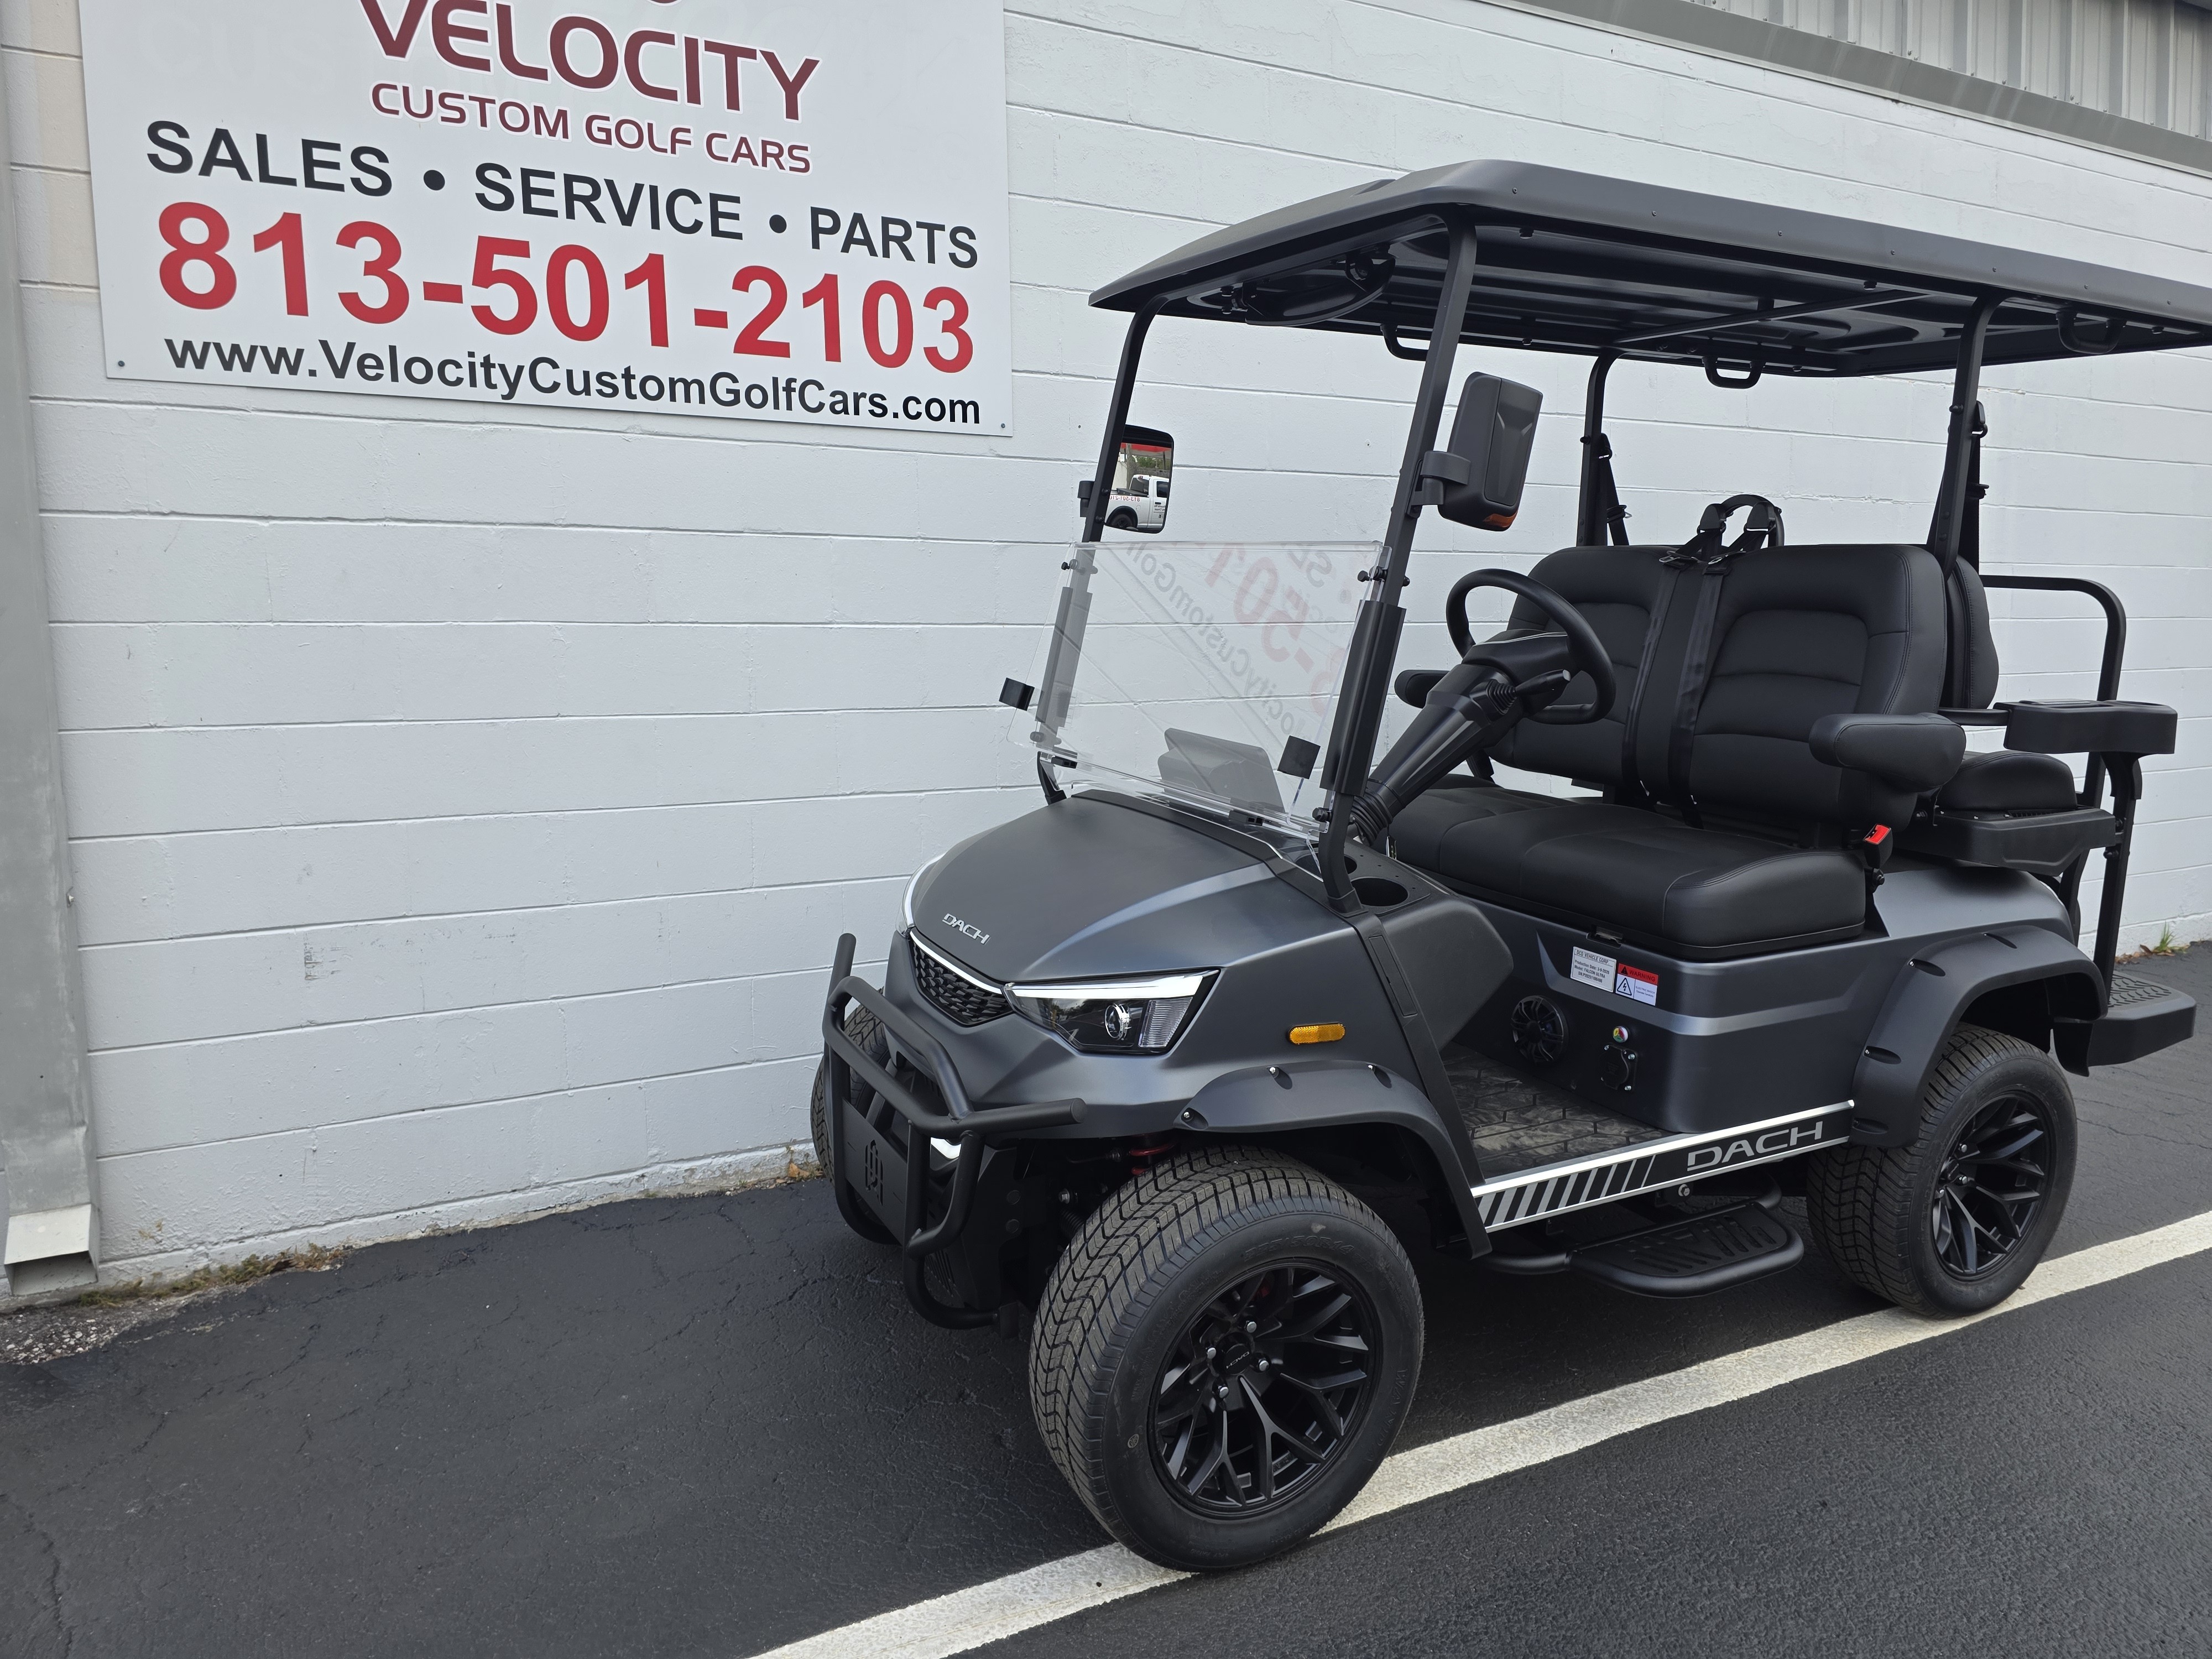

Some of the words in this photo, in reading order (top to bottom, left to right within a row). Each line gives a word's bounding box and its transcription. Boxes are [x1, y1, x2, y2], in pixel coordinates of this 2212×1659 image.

[359, 0, 820, 121] VELOCITY
[372, 83, 569, 139] CUSTOM
[585, 114, 692, 155] GOLF
[706, 133, 810, 173] CARS
[147, 120, 392, 197] SALES
[475, 163, 743, 241] SERVICE
[810, 206, 978, 269] PARTS
[159, 201, 973, 373] 813-501-2103
[164, 338, 980, 424] www.VelocityCustomGolfCars.com
[942, 913, 990, 944] DACH
[1574, 959, 1589, 968] Production
[1584, 952, 1598, 961] VEHICLE
[1629, 969, 1656, 982] WARNING
[1687, 1121, 1823, 1171] DACH
[1226, 1351, 1250, 1369] DACH
